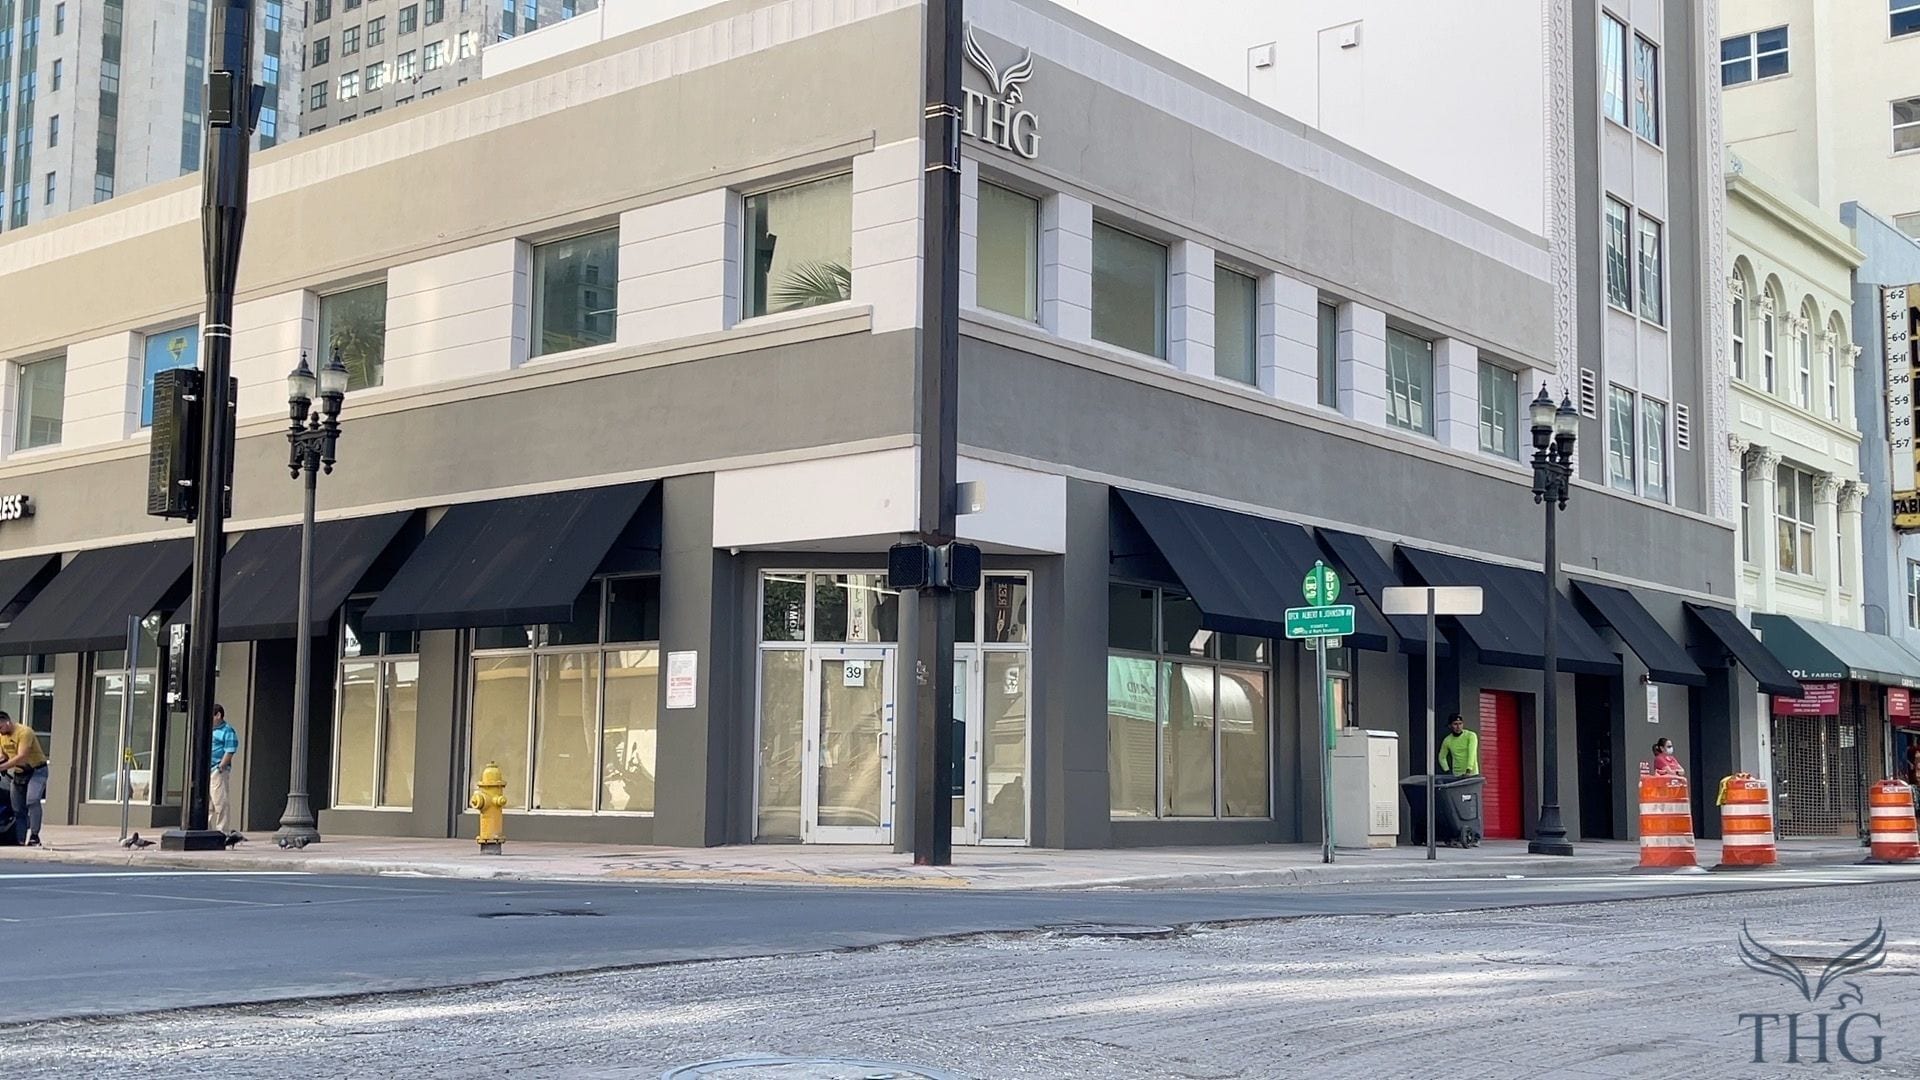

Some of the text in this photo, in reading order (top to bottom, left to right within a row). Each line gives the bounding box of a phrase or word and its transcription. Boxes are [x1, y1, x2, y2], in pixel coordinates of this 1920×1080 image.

[961, 86, 1041, 159] THG
[0, 494, 22, 520] ESS
[1325, 571, 1335, 601] BUS
[846, 667, 861, 678] 39
